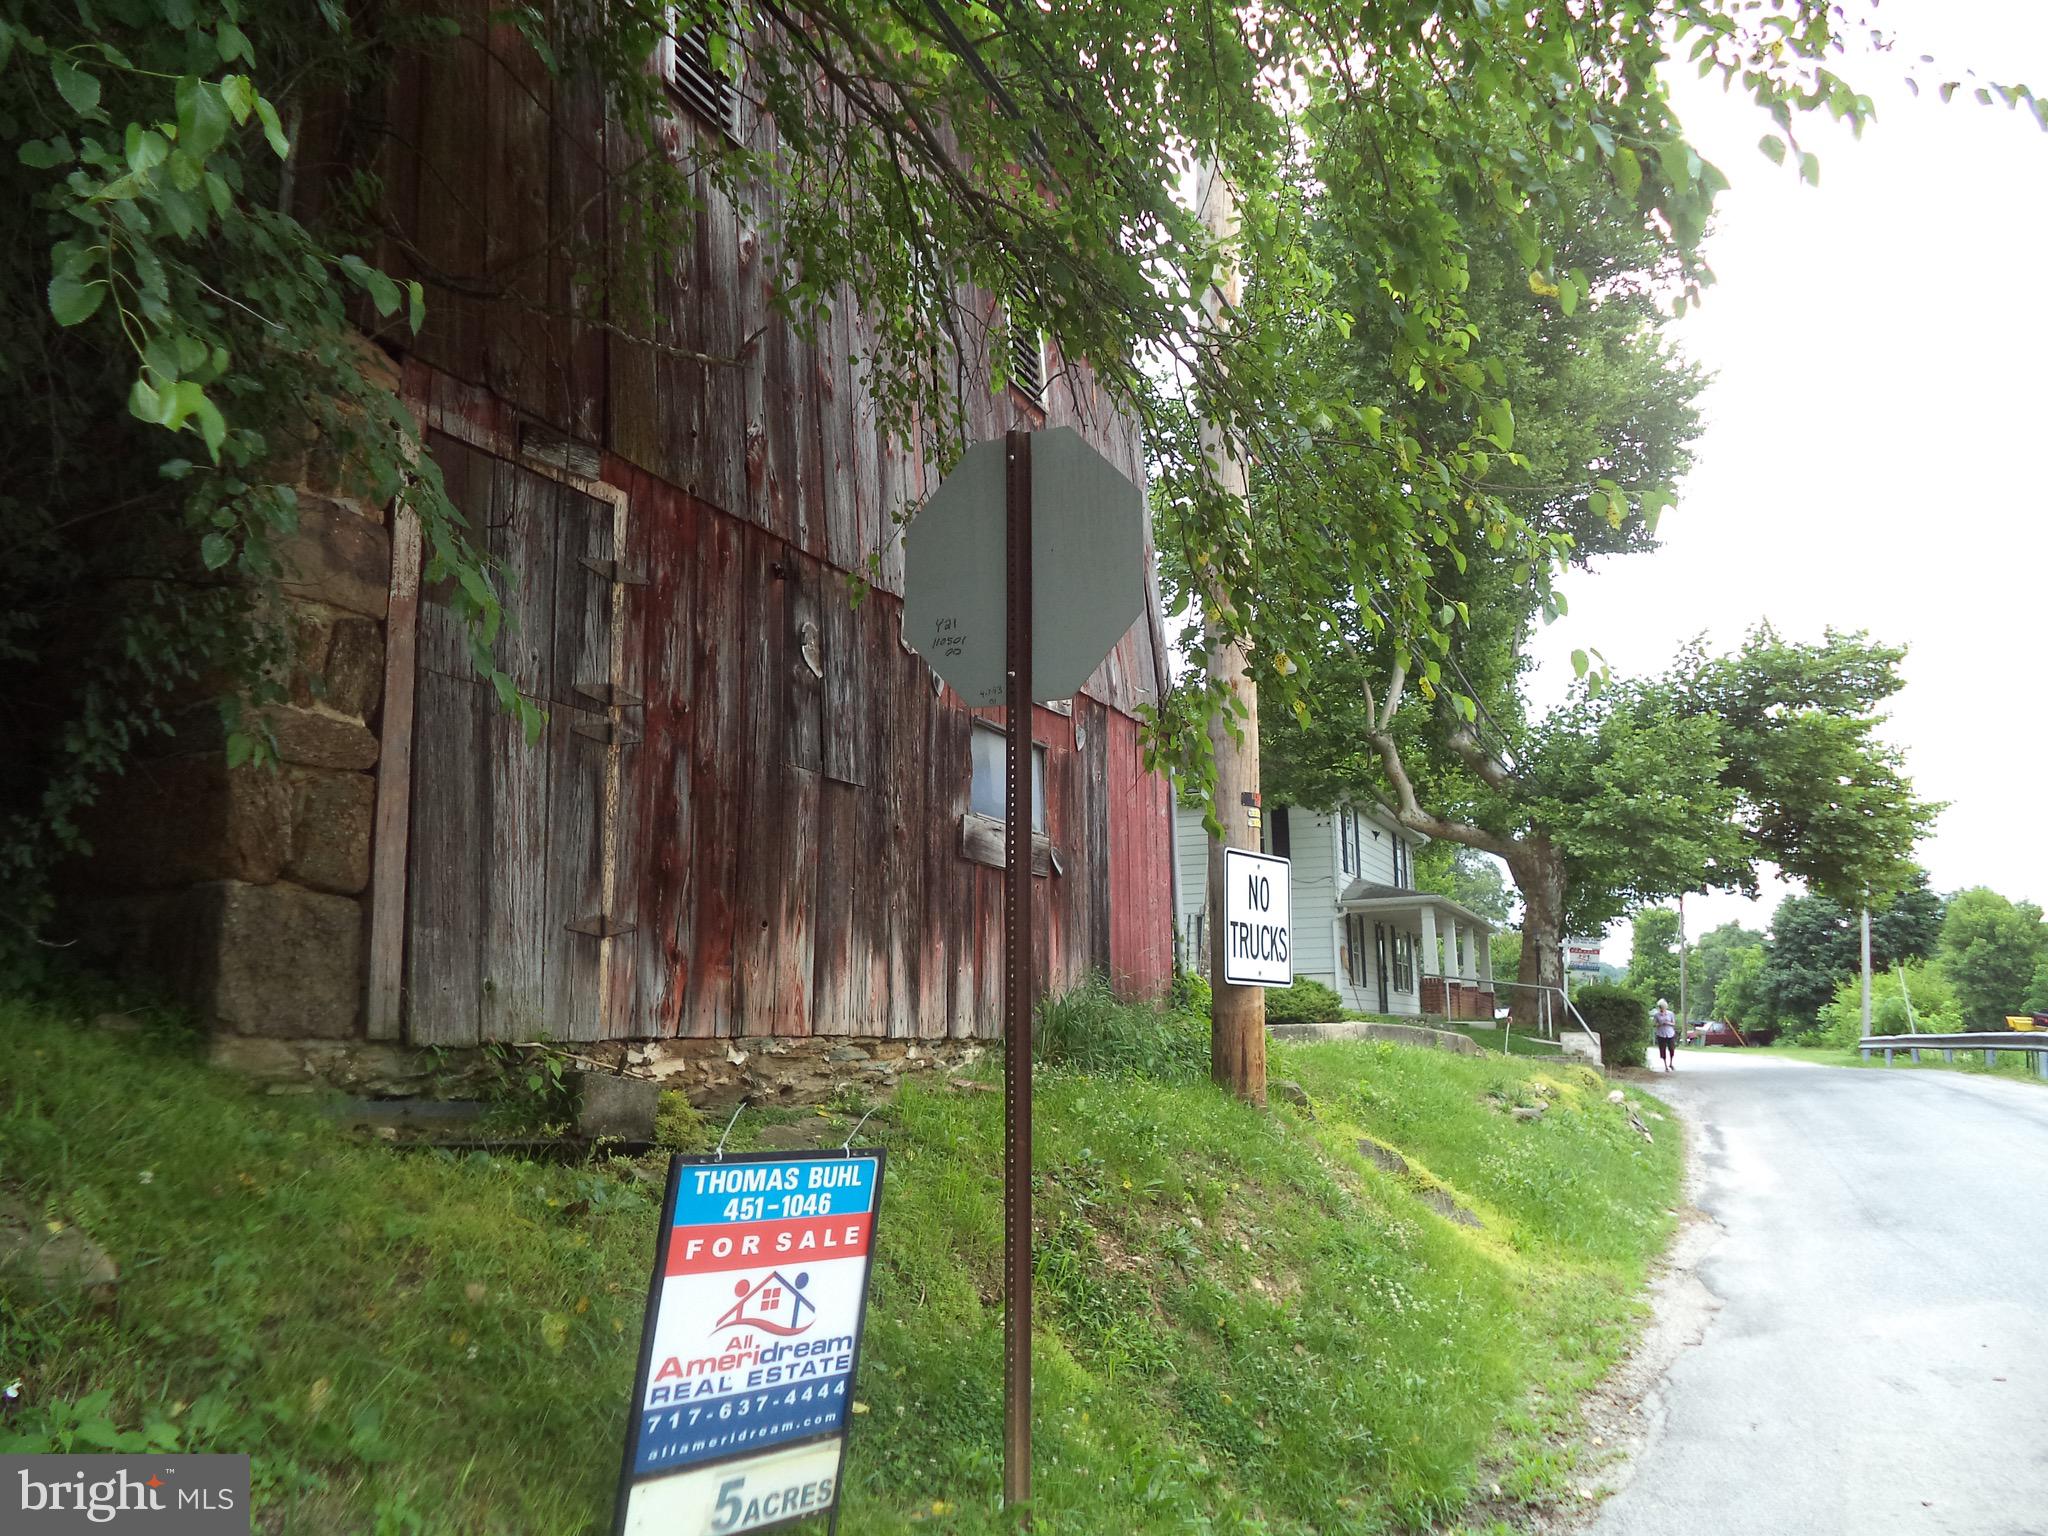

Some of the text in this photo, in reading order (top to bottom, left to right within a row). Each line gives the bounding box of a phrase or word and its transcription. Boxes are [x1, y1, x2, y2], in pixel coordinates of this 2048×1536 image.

[1248, 874, 1270, 913] NO
[1230, 921, 1288, 963] TRUCKS
[694, 1165, 862, 1195] THOMAS BUHL
[723, 1193, 832, 1221] 451-1046
[685, 1226, 861, 1260] FOR SALE
[654, 1335, 853, 1382] Ameridream
[725, 1335, 753, 1352] All
[650, 1354, 850, 1405] REAL ESTATE
[647, 1380, 846, 1435] 717-637-4444
[647, 1412, 837, 1461] allameridream.com
[711, 1474, 834, 1532] 5 ACRES
